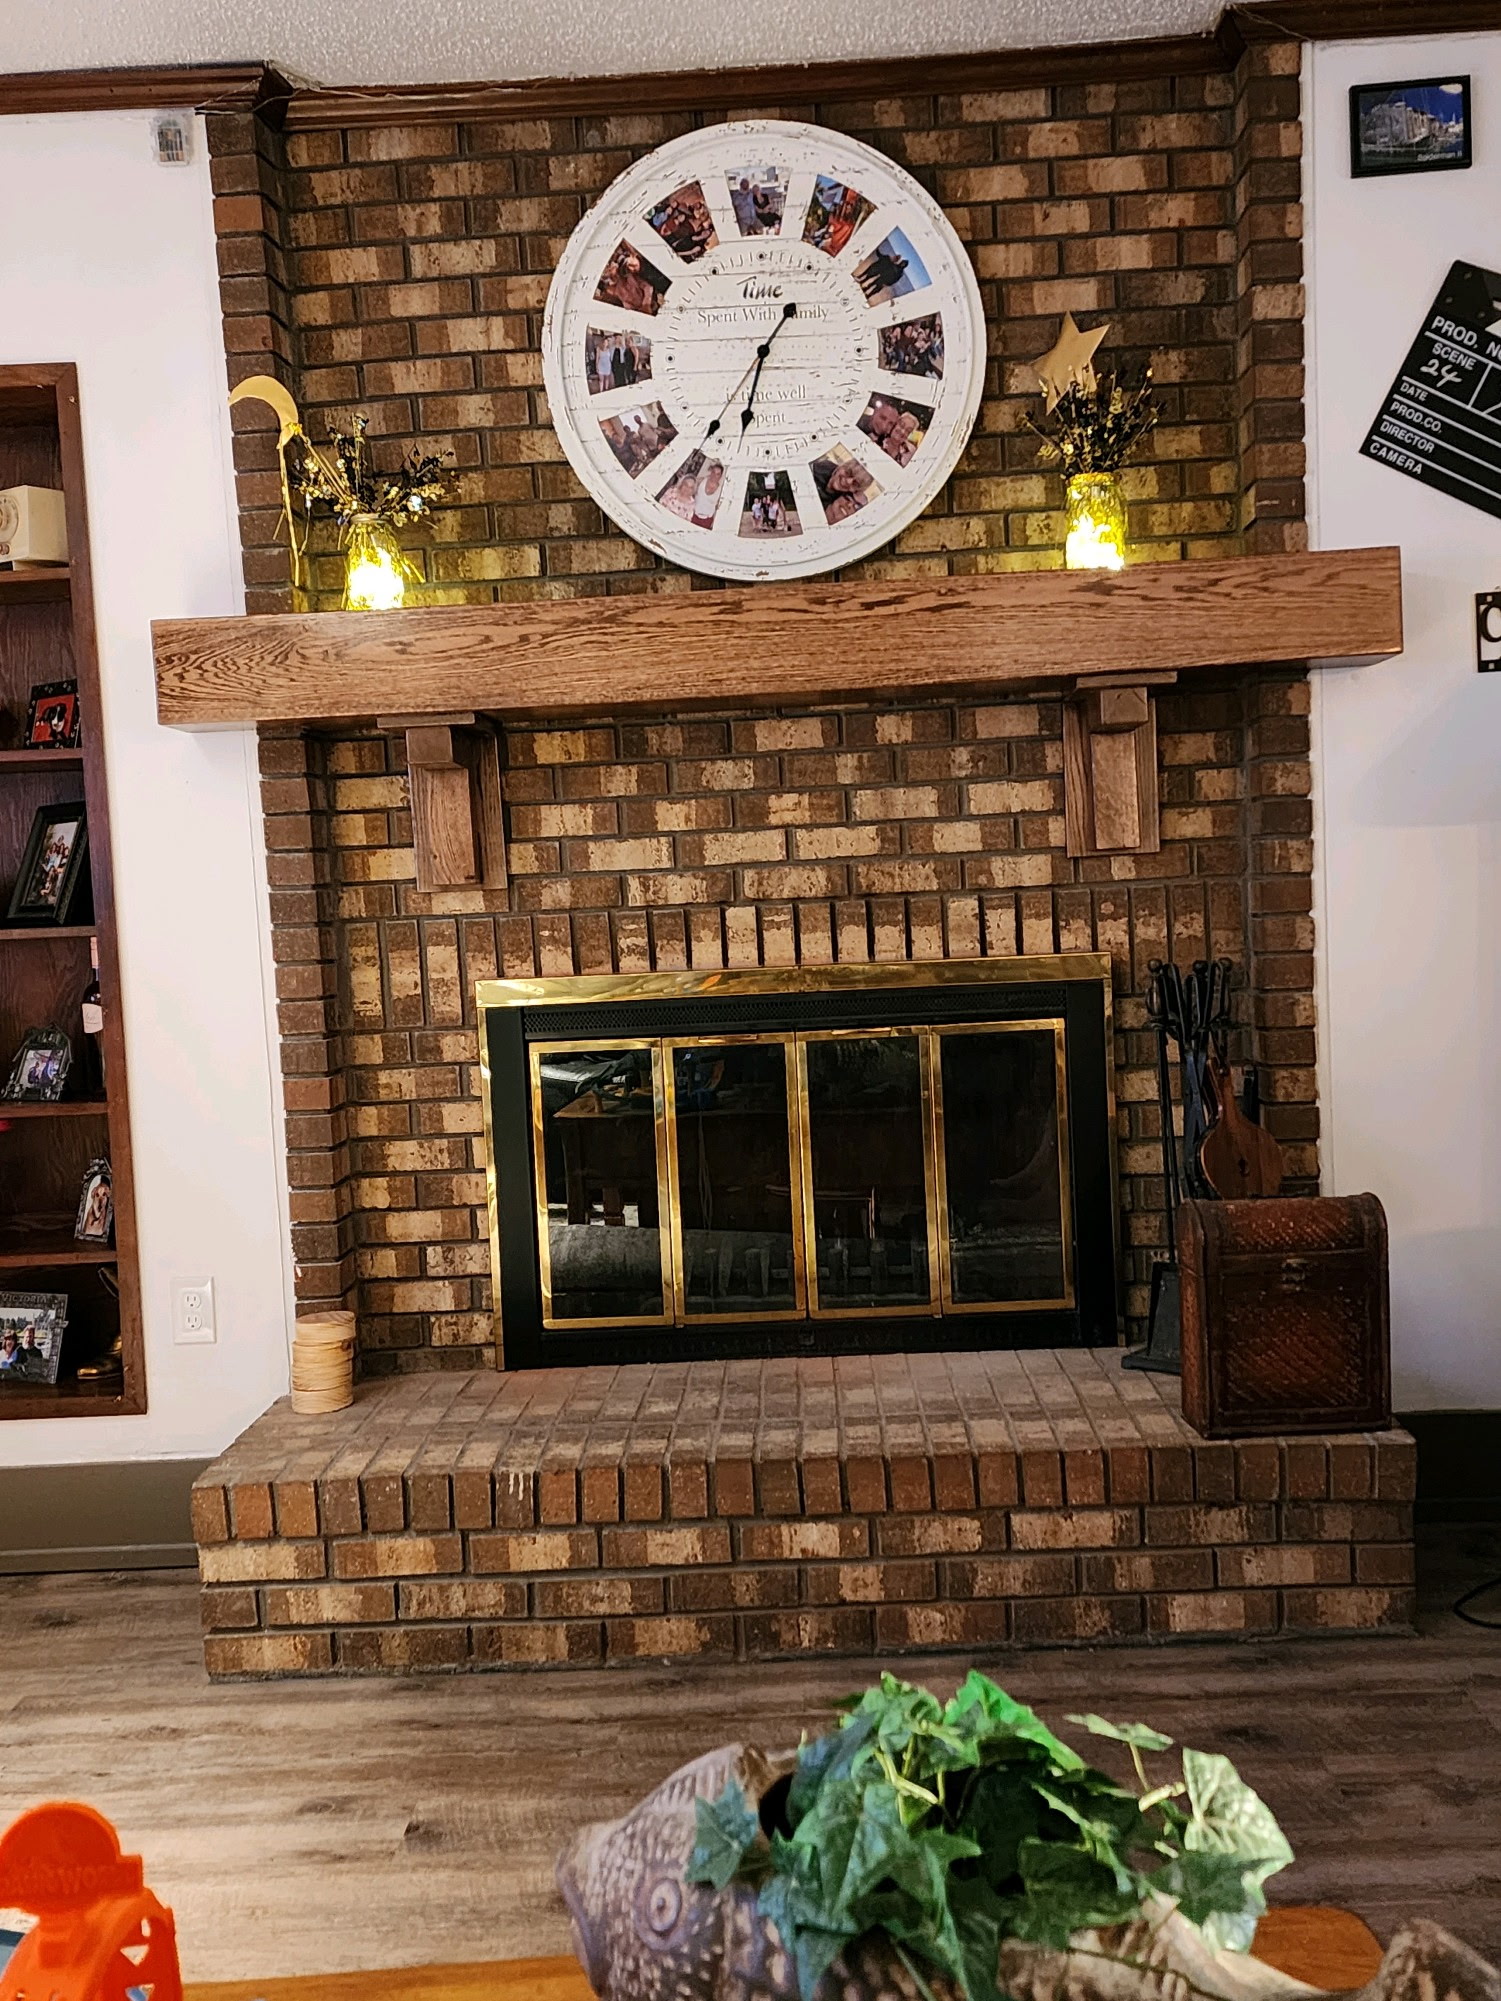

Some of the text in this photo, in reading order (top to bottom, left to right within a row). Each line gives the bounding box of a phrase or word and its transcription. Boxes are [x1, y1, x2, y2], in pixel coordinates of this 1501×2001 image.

[737, 276, 783, 299] Time
[697, 304, 828, 327] Spent With amily
[1432, 342, 1477, 371] SCENE
[1485, 341, 1501, 362] N
[1419, 358, 1463, 388] 24
[778, 384, 806, 399] well
[1400, 382, 1429, 402] DATE
[750, 411, 785, 428] pent
[1380, 421, 1435, 454] DIRECTOR
[1369, 442, 1423, 475] CAMERA
[2, 1293, 47, 1303] VICTORIA
